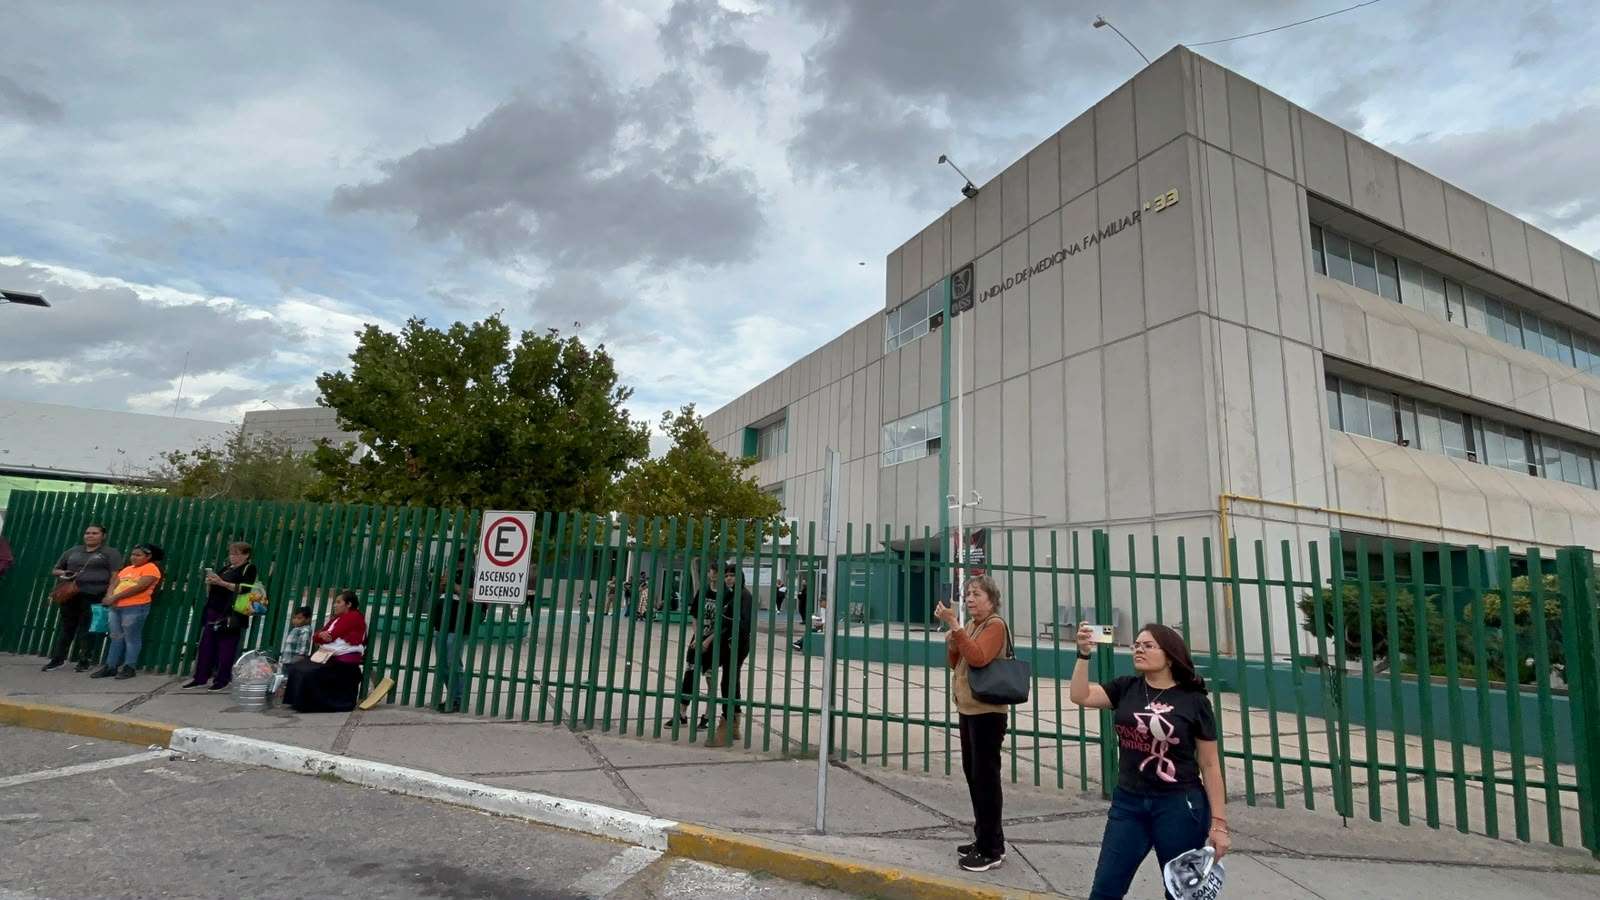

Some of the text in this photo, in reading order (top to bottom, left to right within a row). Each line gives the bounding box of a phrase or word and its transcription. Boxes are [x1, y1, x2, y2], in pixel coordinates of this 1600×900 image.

[979, 277, 1014, 303] UNIDAD
[1015, 268, 1028, 285] DE
[1028, 242, 1081, 278] MEDICINA
[1083, 210, 1142, 250] FAMILIAR
[1154, 188, 1179, 213] 33
[495, 526, 516, 557] E
[479, 571, 525, 583] ASCENSO Y
[478, 585, 520, 598] DESCENSO
